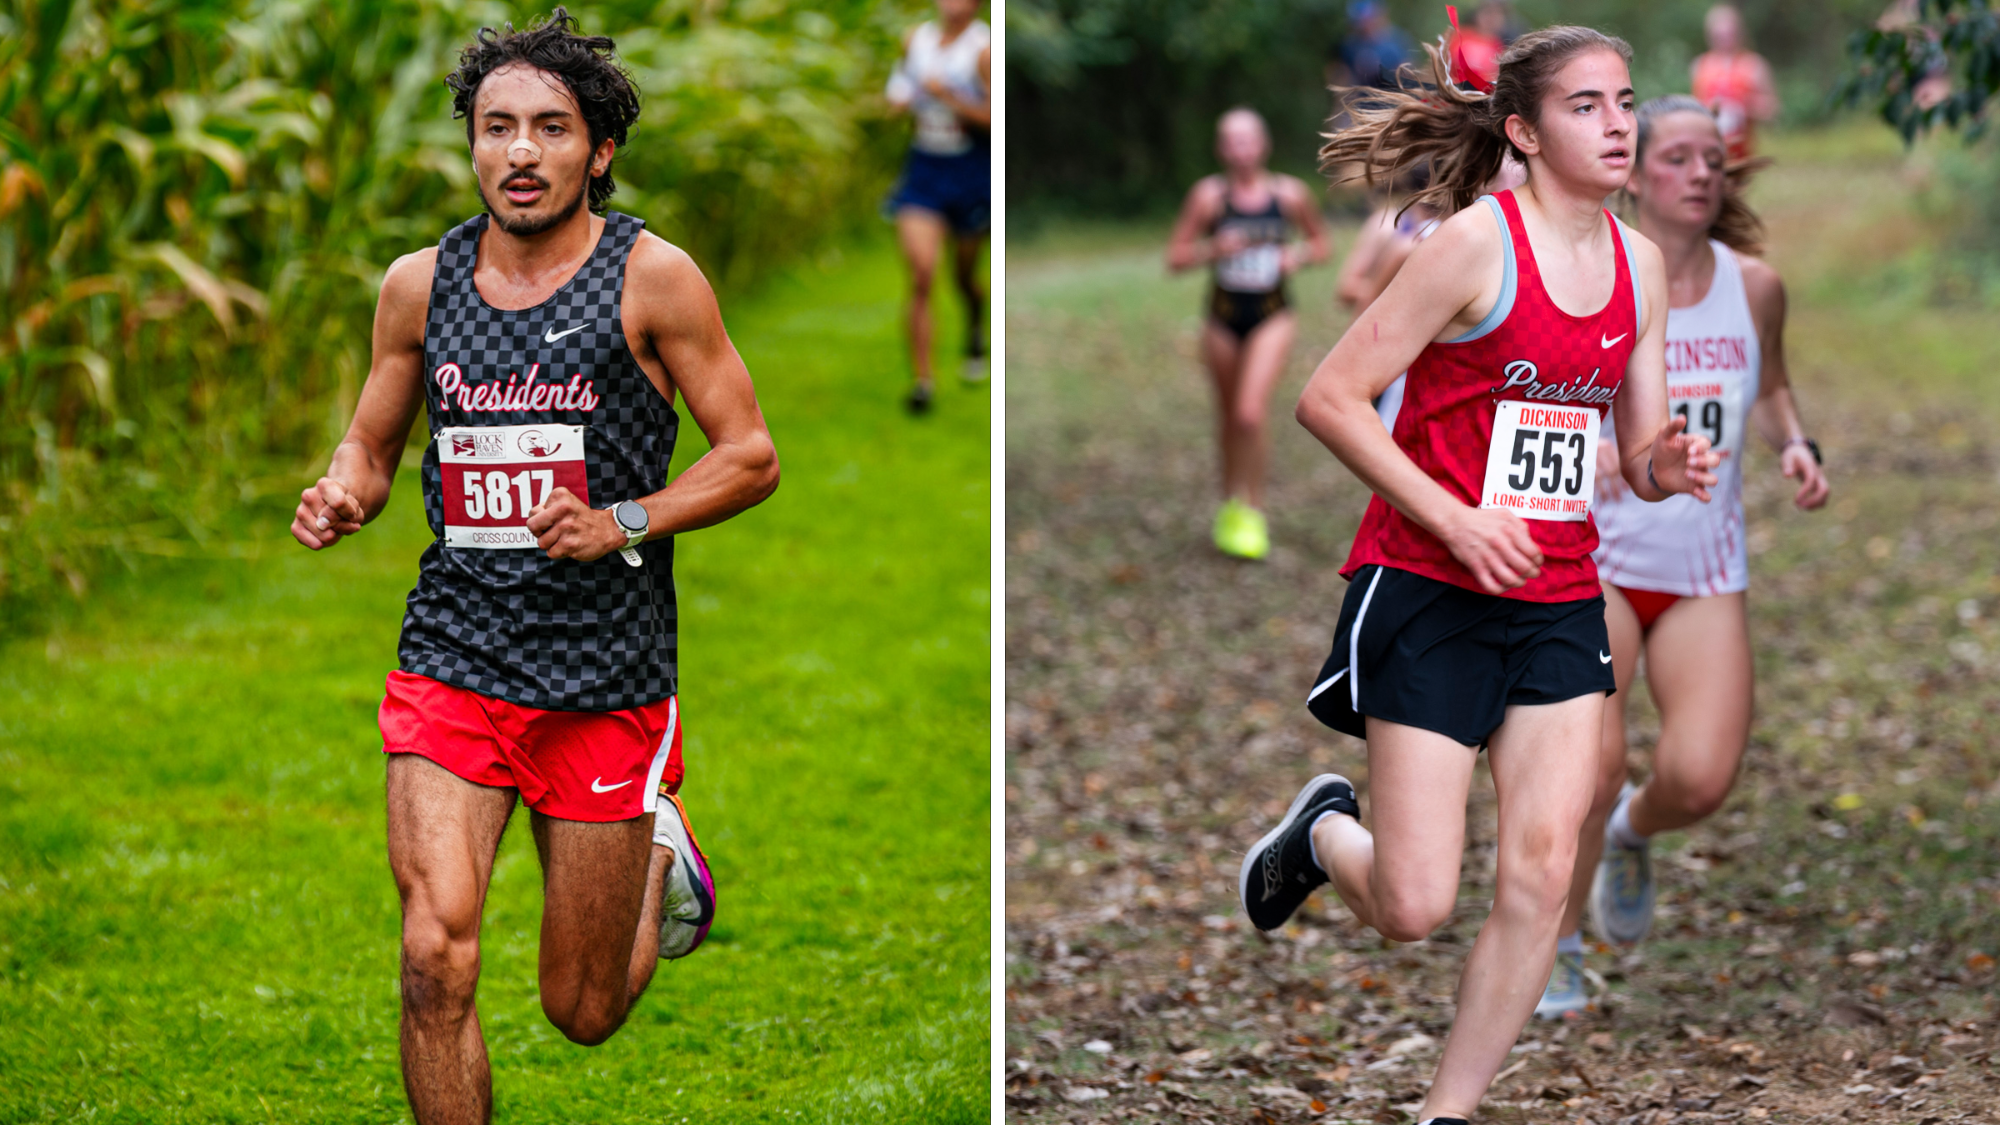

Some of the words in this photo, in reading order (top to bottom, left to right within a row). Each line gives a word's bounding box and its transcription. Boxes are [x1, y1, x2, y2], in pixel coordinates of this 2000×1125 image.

[435, 362, 600, 412] Presidents
[1519, 408, 1588, 430] DICKINSON
[475, 434, 502, 444] LOCK
[475, 444, 503, 452] HAVEN
[1508, 428, 1585, 495] 553
[463, 469, 554, 520] 5817
[1493, 493, 1561, 512] LONG-SHORT
[1563, 500, 1588, 513] INVITE
[472, 533, 501, 543] CROSS
